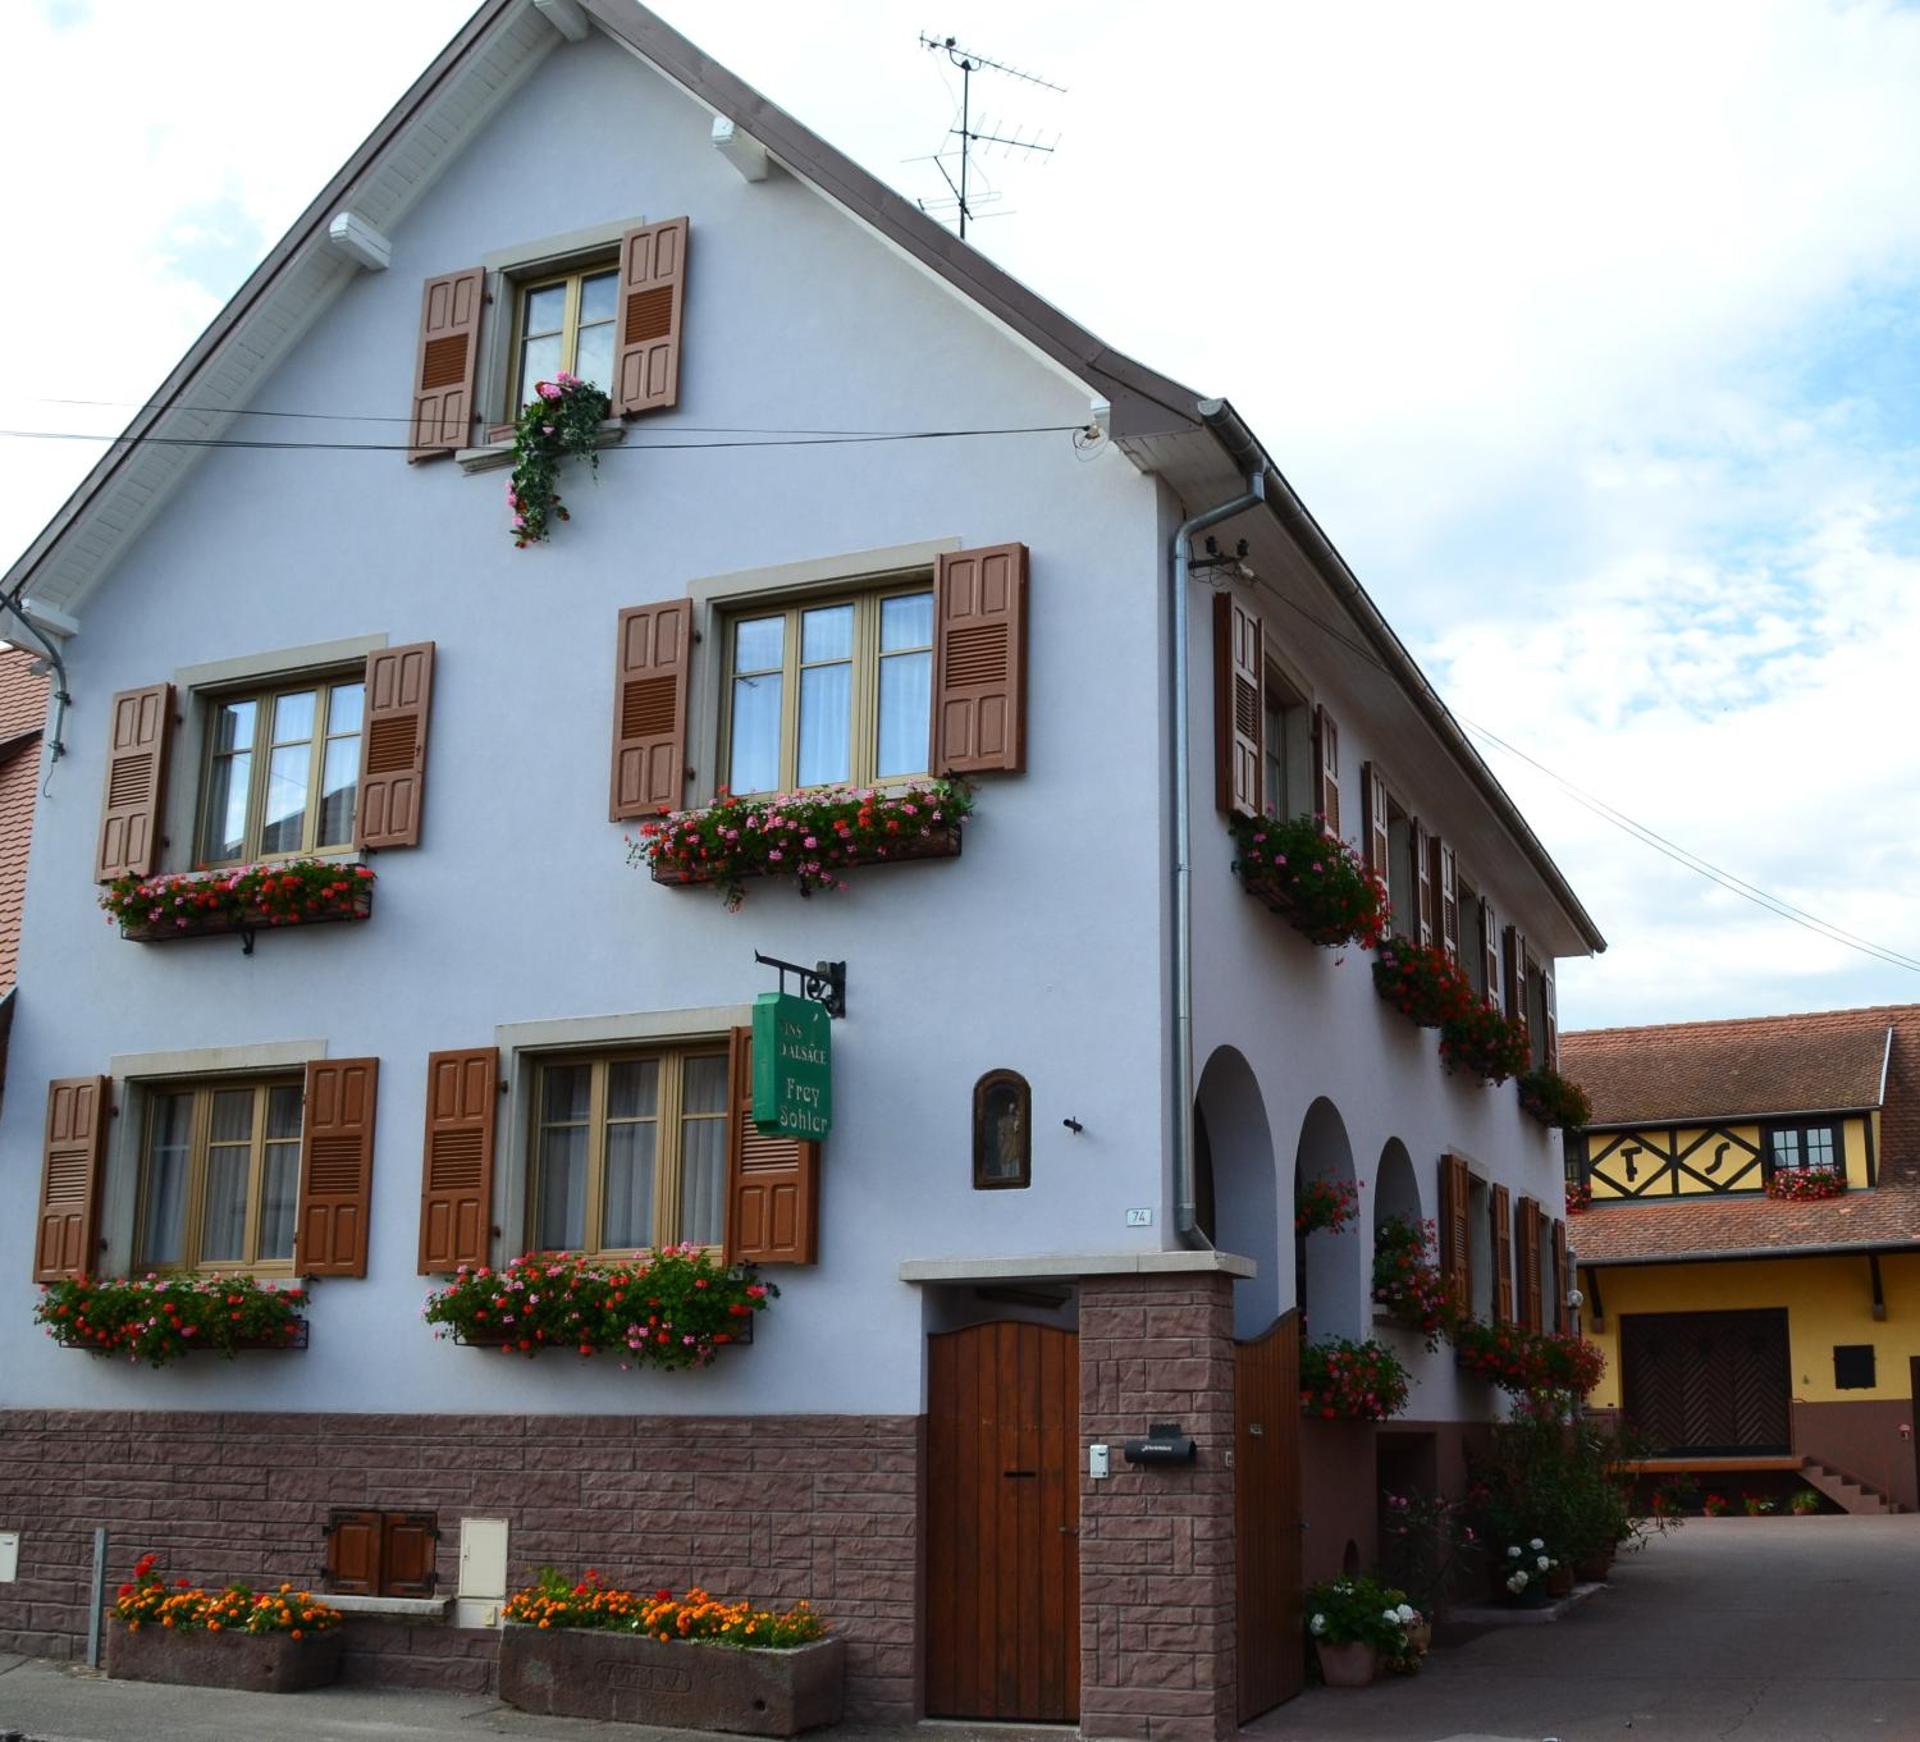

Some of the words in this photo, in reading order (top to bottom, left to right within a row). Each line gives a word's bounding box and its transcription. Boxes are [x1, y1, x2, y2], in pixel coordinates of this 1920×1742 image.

[780, 1020, 804, 1039] INS
[786, 1077, 820, 1108] Frey
[780, 1104, 828, 1134] Sohler
[1132, 1211, 1145, 1222] 74
